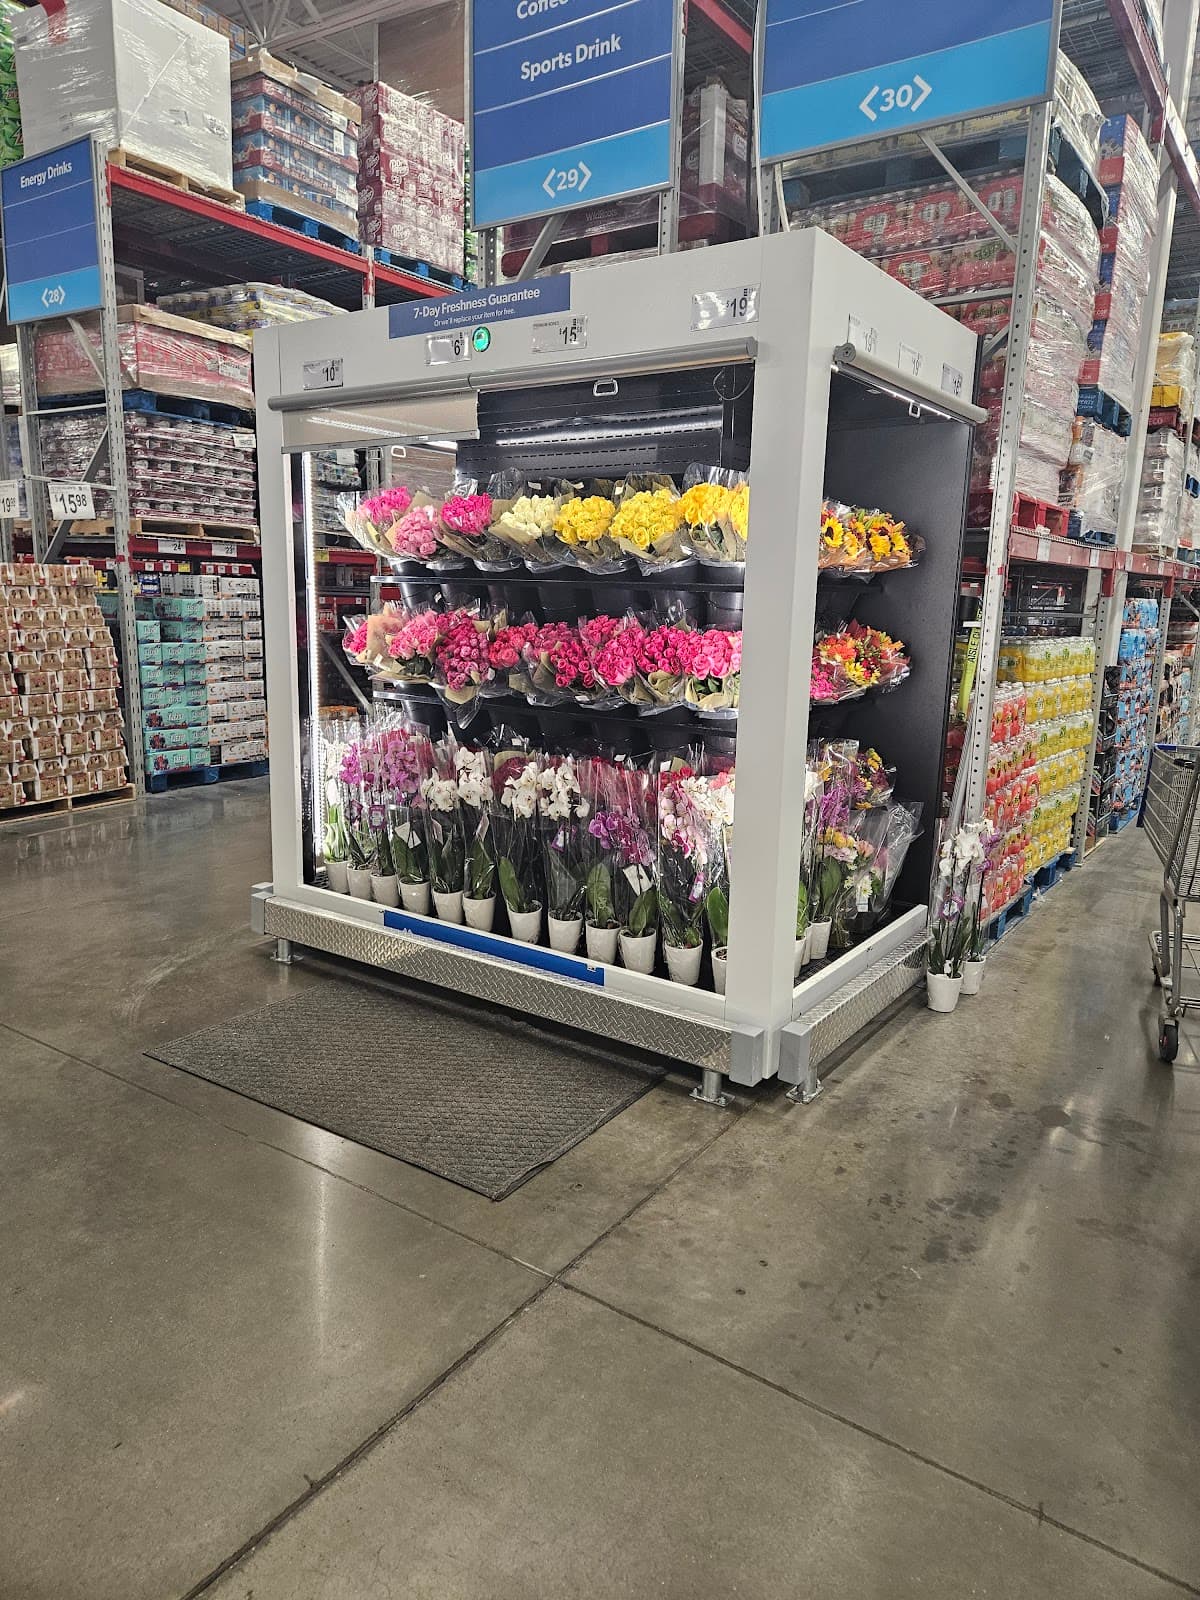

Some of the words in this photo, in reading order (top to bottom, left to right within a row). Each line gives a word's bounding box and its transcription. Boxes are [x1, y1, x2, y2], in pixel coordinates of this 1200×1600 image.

[520, 51, 573, 81] Sports
[575, 33, 622, 64] Drink
[879, 84, 913, 112] 30
[20, 170, 47, 189] Energy
[47, 160, 73, 180] Drinks
[556, 168, 579, 191] 29
[47, 288, 60, 304] 28
[413, 304, 441, 319] 7-Day
[441, 295, 487, 315] Freshness
[487, 287, 541, 306] Guarantee
[453, 315, 472, 325] replace
[472, 313, 484, 323] your
[483, 311, 496, 319] item
[496, 309, 504, 317] for
